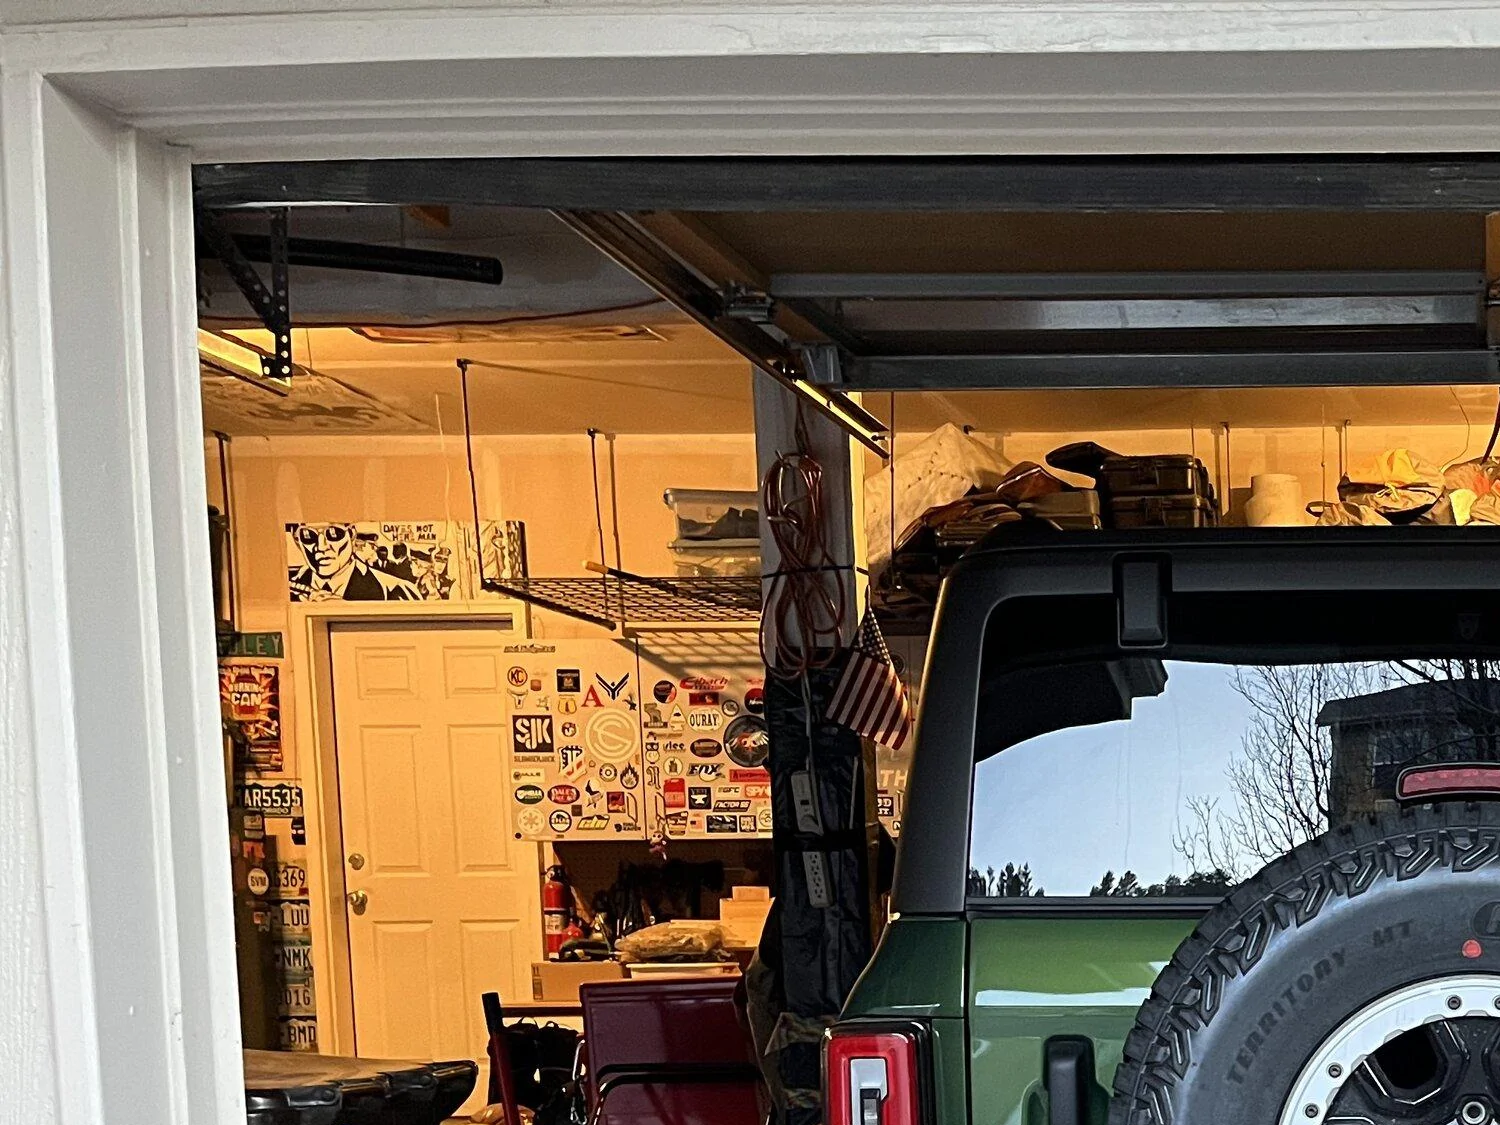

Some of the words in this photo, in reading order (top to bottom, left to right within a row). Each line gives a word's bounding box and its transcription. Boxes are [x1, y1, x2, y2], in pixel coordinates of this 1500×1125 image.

[231, 692, 262, 707] CAN
[515, 718, 552, 750] SJK
[1225, 947, 1348, 1085] TERRITORY
